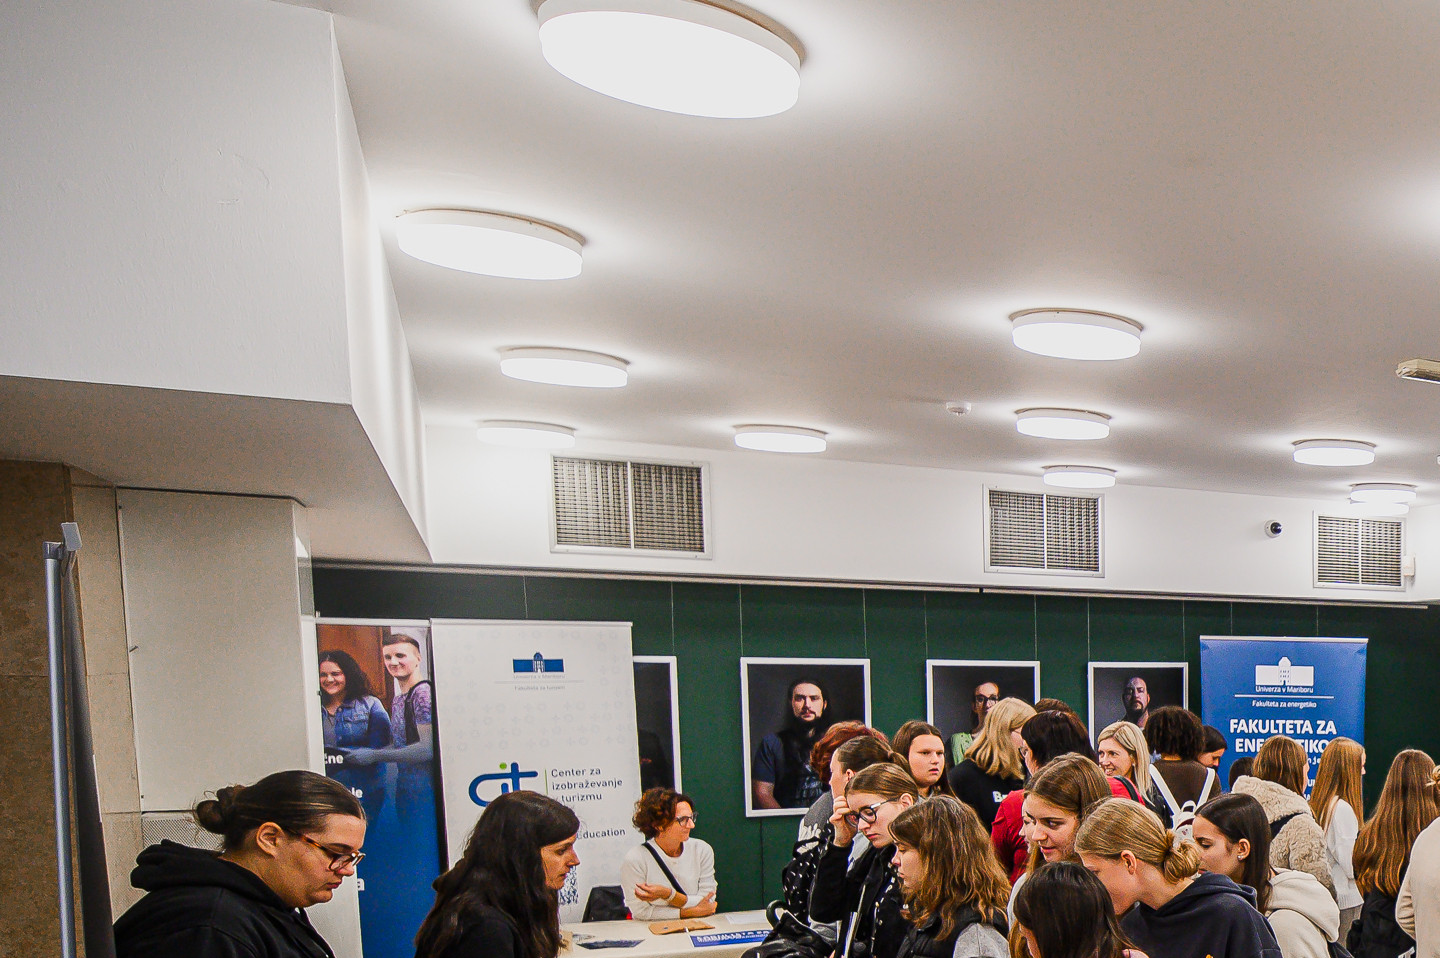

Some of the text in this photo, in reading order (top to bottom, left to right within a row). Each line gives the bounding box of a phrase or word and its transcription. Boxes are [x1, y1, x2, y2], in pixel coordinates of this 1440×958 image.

[1255, 685, 1282, 693] Univerza
[1286, 686, 1314, 694] Mariboru
[1252, 699, 1279, 708] Fakulteta
[1229, 718, 1338, 735] FAKULTETA ZA
[551, 769, 586, 778] Center
[552, 779, 623, 790] izobraževanje
[561, 793, 602, 803] turizmu
